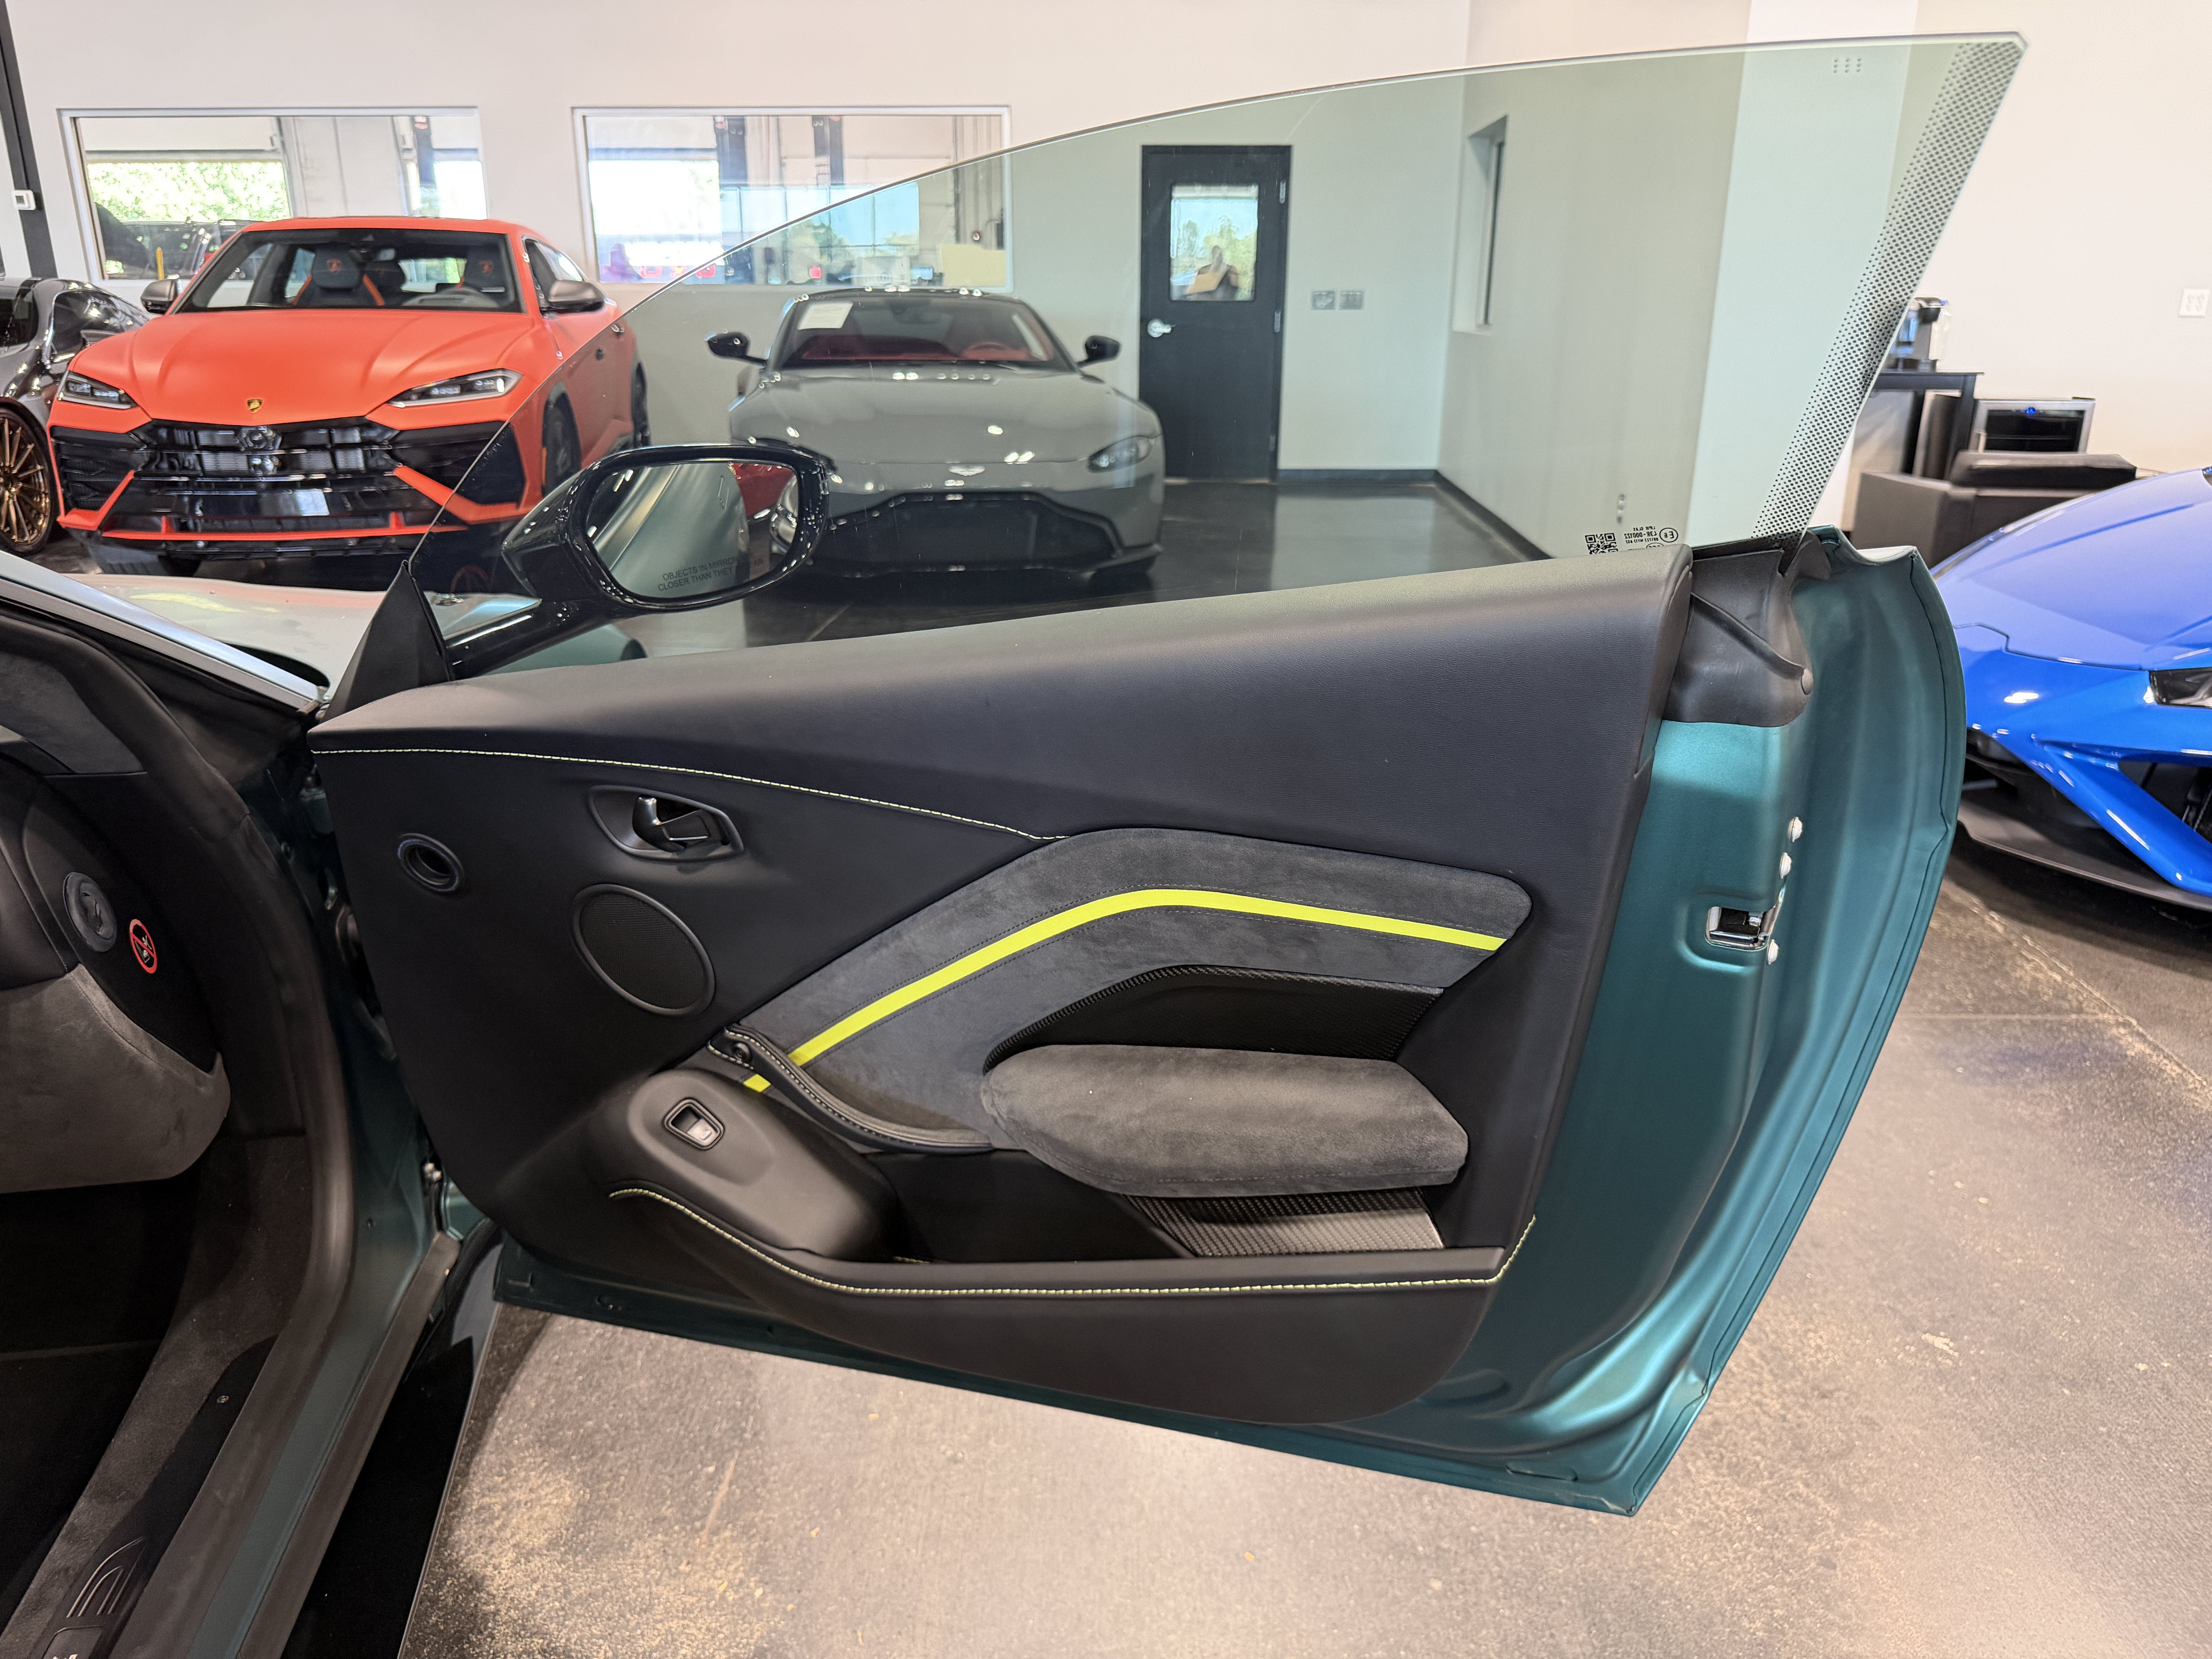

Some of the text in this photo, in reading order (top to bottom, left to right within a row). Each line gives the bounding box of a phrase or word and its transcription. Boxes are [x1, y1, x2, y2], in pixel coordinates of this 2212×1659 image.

[658, 566, 732, 591] CLOSER THAN THEY
[663, 567, 698, 580] OBJECTS
